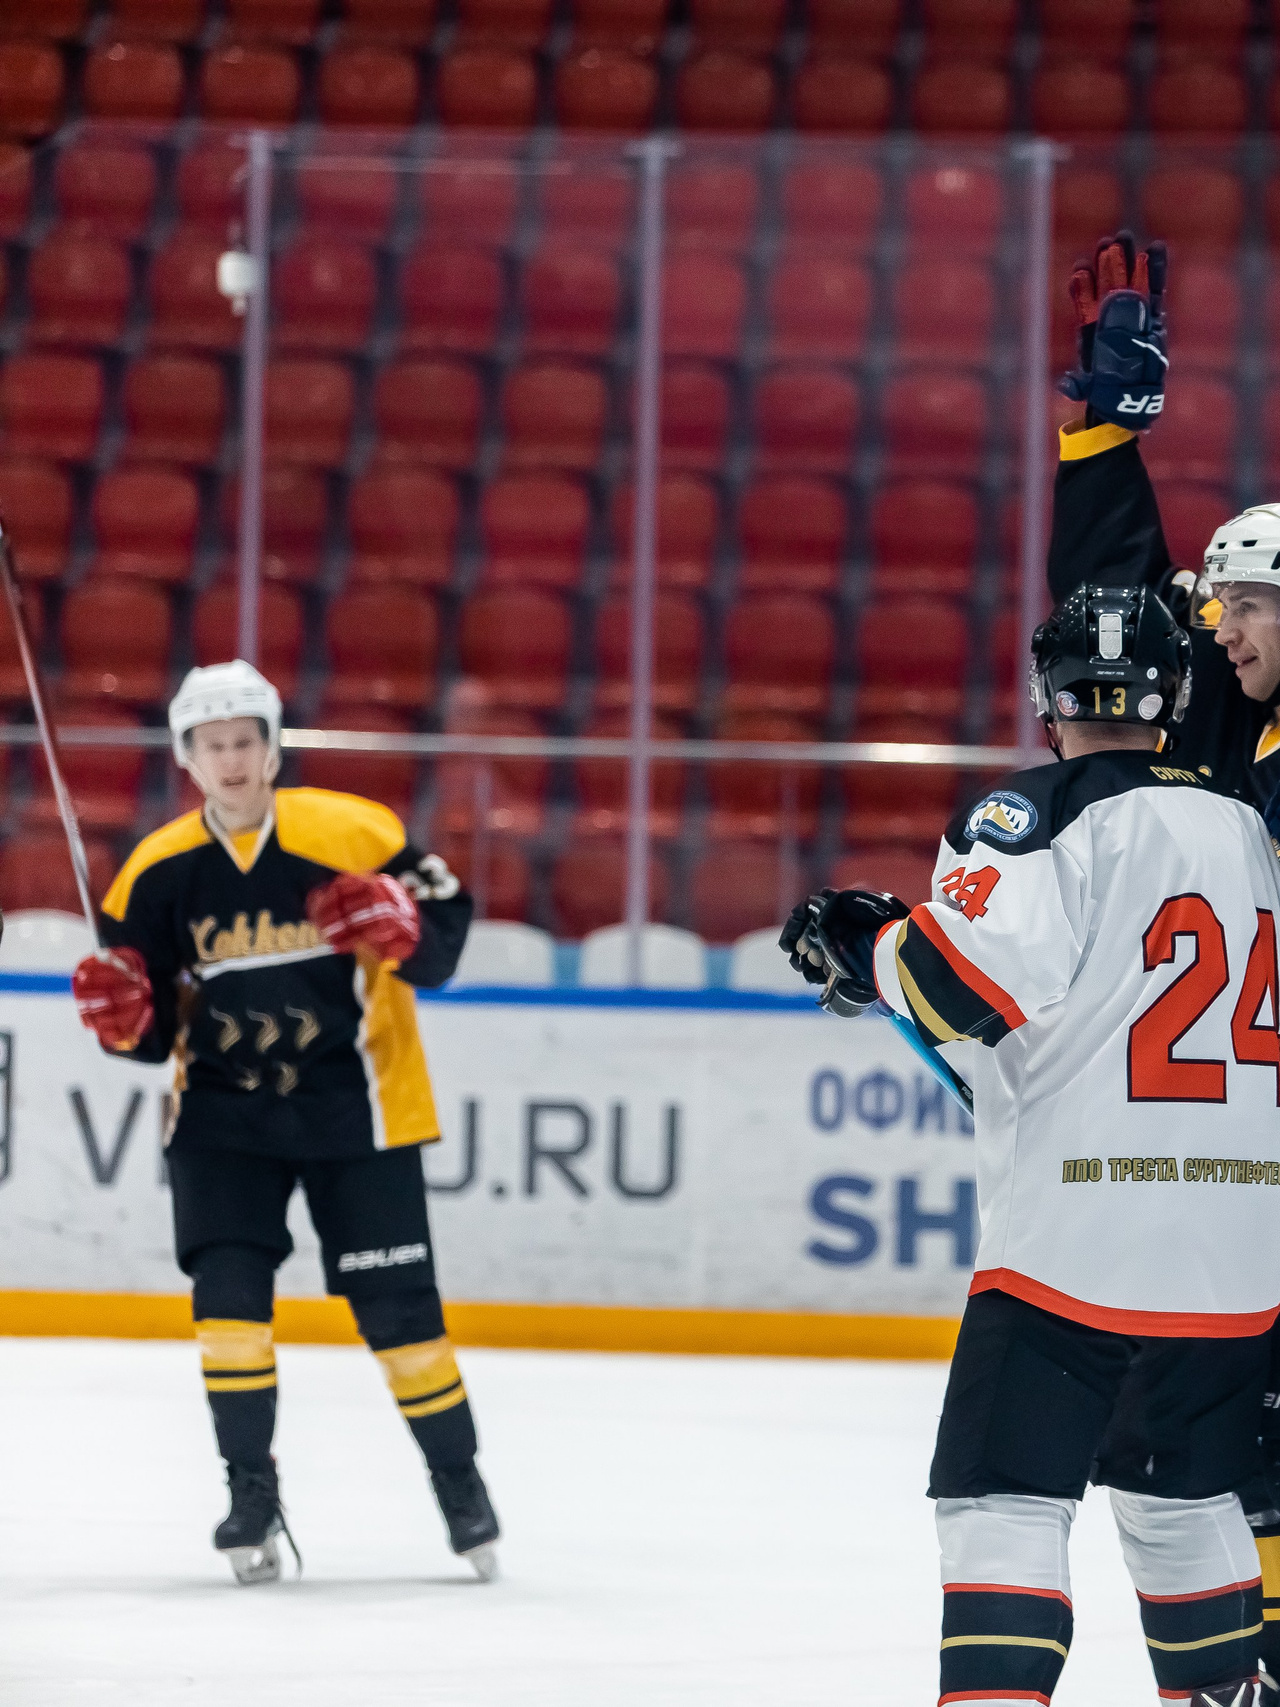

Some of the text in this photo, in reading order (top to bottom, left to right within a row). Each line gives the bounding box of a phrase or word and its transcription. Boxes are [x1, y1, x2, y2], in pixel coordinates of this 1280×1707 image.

[1092, 686, 1126, 715] 13
[1062, 1158, 1103, 1183] ППО
[1108, 1157, 1179, 1182] ТРЕСТА
